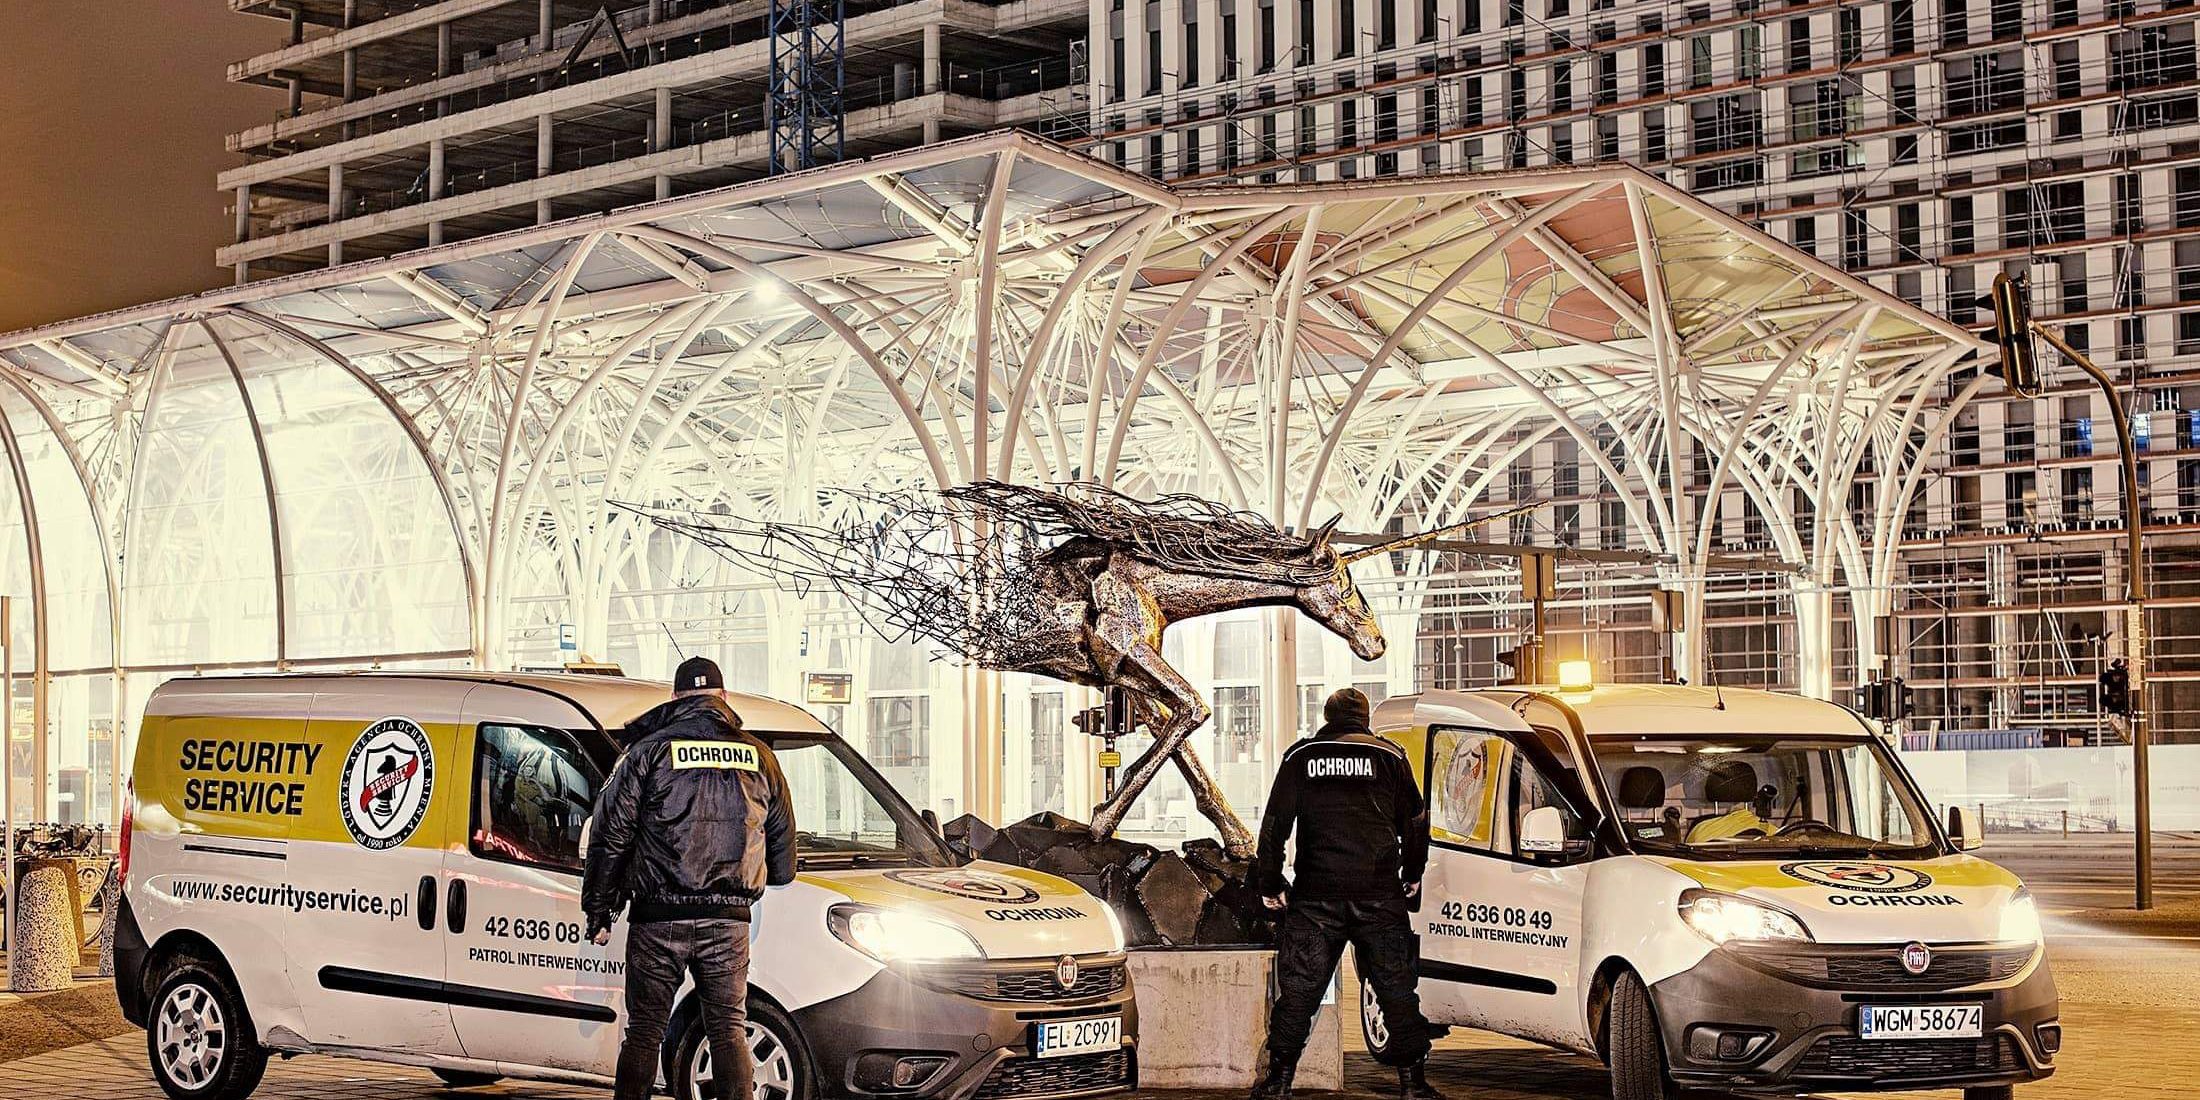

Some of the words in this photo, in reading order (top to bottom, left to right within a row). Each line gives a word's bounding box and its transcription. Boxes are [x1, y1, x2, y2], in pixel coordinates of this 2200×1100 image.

[180, 739, 323, 776] SECURITY
[351, 722, 394, 763] AGENCJA
[398, 722, 431, 770] OCHRONY
[678, 746, 754, 765] OCHRONA
[1307, 758, 1373, 777] OCHRONA
[184, 779, 305, 815] SERVICE
[367, 838, 383, 848] 1990
[385, 835, 402, 847] roku
[173, 881, 408, 921] www.securityservice.pl
[985, 906, 1087, 921] OCHRONA
[1828, 894, 1963, 908] OCHRONA
[1441, 902, 1462, 920] 42
[1467, 904, 1499, 924] 636
[1504, 907, 1526, 927] 08
[1529, 910, 1552, 930] 49
[485, 916, 509, 937] 42
[513, 918, 550, 941] 636
[555, 922, 580, 944] 08
[1429, 923, 1470, 938] PATROL
[1472, 926, 1569, 949] INTERWENCYJNY
[469, 948, 515, 965] PATROL
[518, 952, 625, 975] INTERWENCYJNY
[1909, 951, 1925, 966] FIAT
[1874, 1009, 1913, 1031] WGM
[1920, 1008, 1981, 1030] 58674
[1047, 1026, 1068, 1049] EL
[1074, 1020, 1116, 1046] 2C991
